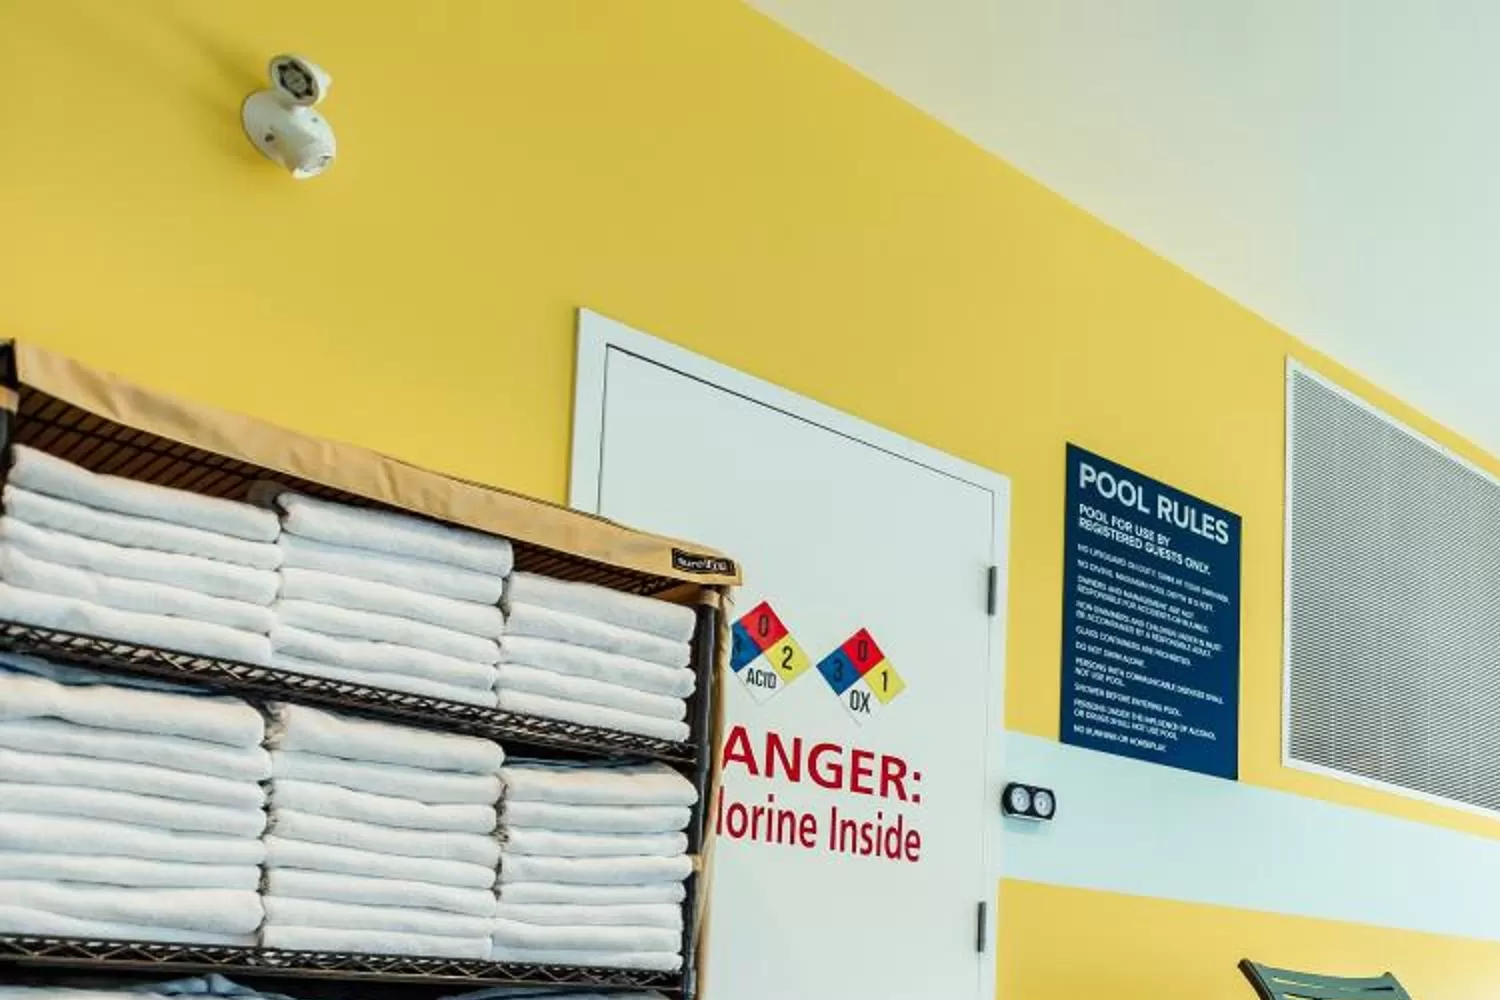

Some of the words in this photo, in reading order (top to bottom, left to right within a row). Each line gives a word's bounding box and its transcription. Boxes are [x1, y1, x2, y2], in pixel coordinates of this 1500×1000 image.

[1079, 462, 1150, 513] POOL
[1157, 495, 1228, 545] RULES
[1079, 502, 1108, 524] POOL
[1111, 515, 1132, 533] FOR
[1135, 524, 1154, 542] USE
[1157, 533, 1170, 548] BY
[1078, 515, 1142, 550] REGISTERED
[1144, 541, 1182, 565] GUESTS
[1185, 556, 1210, 575] ONLY.
[758, 614, 769, 637] 0
[781, 646, 793, 670] 2
[857, 640, 868, 661] 0
[746, 668, 777, 689] ACID
[833, 658, 843, 682] 3
[881, 670, 888, 691] 1
[850, 690, 871, 714] OX
[721, 725, 921, 804] ANGER:
[716, 785, 817, 848] lorine
[829, 806, 921, 863] Inside
